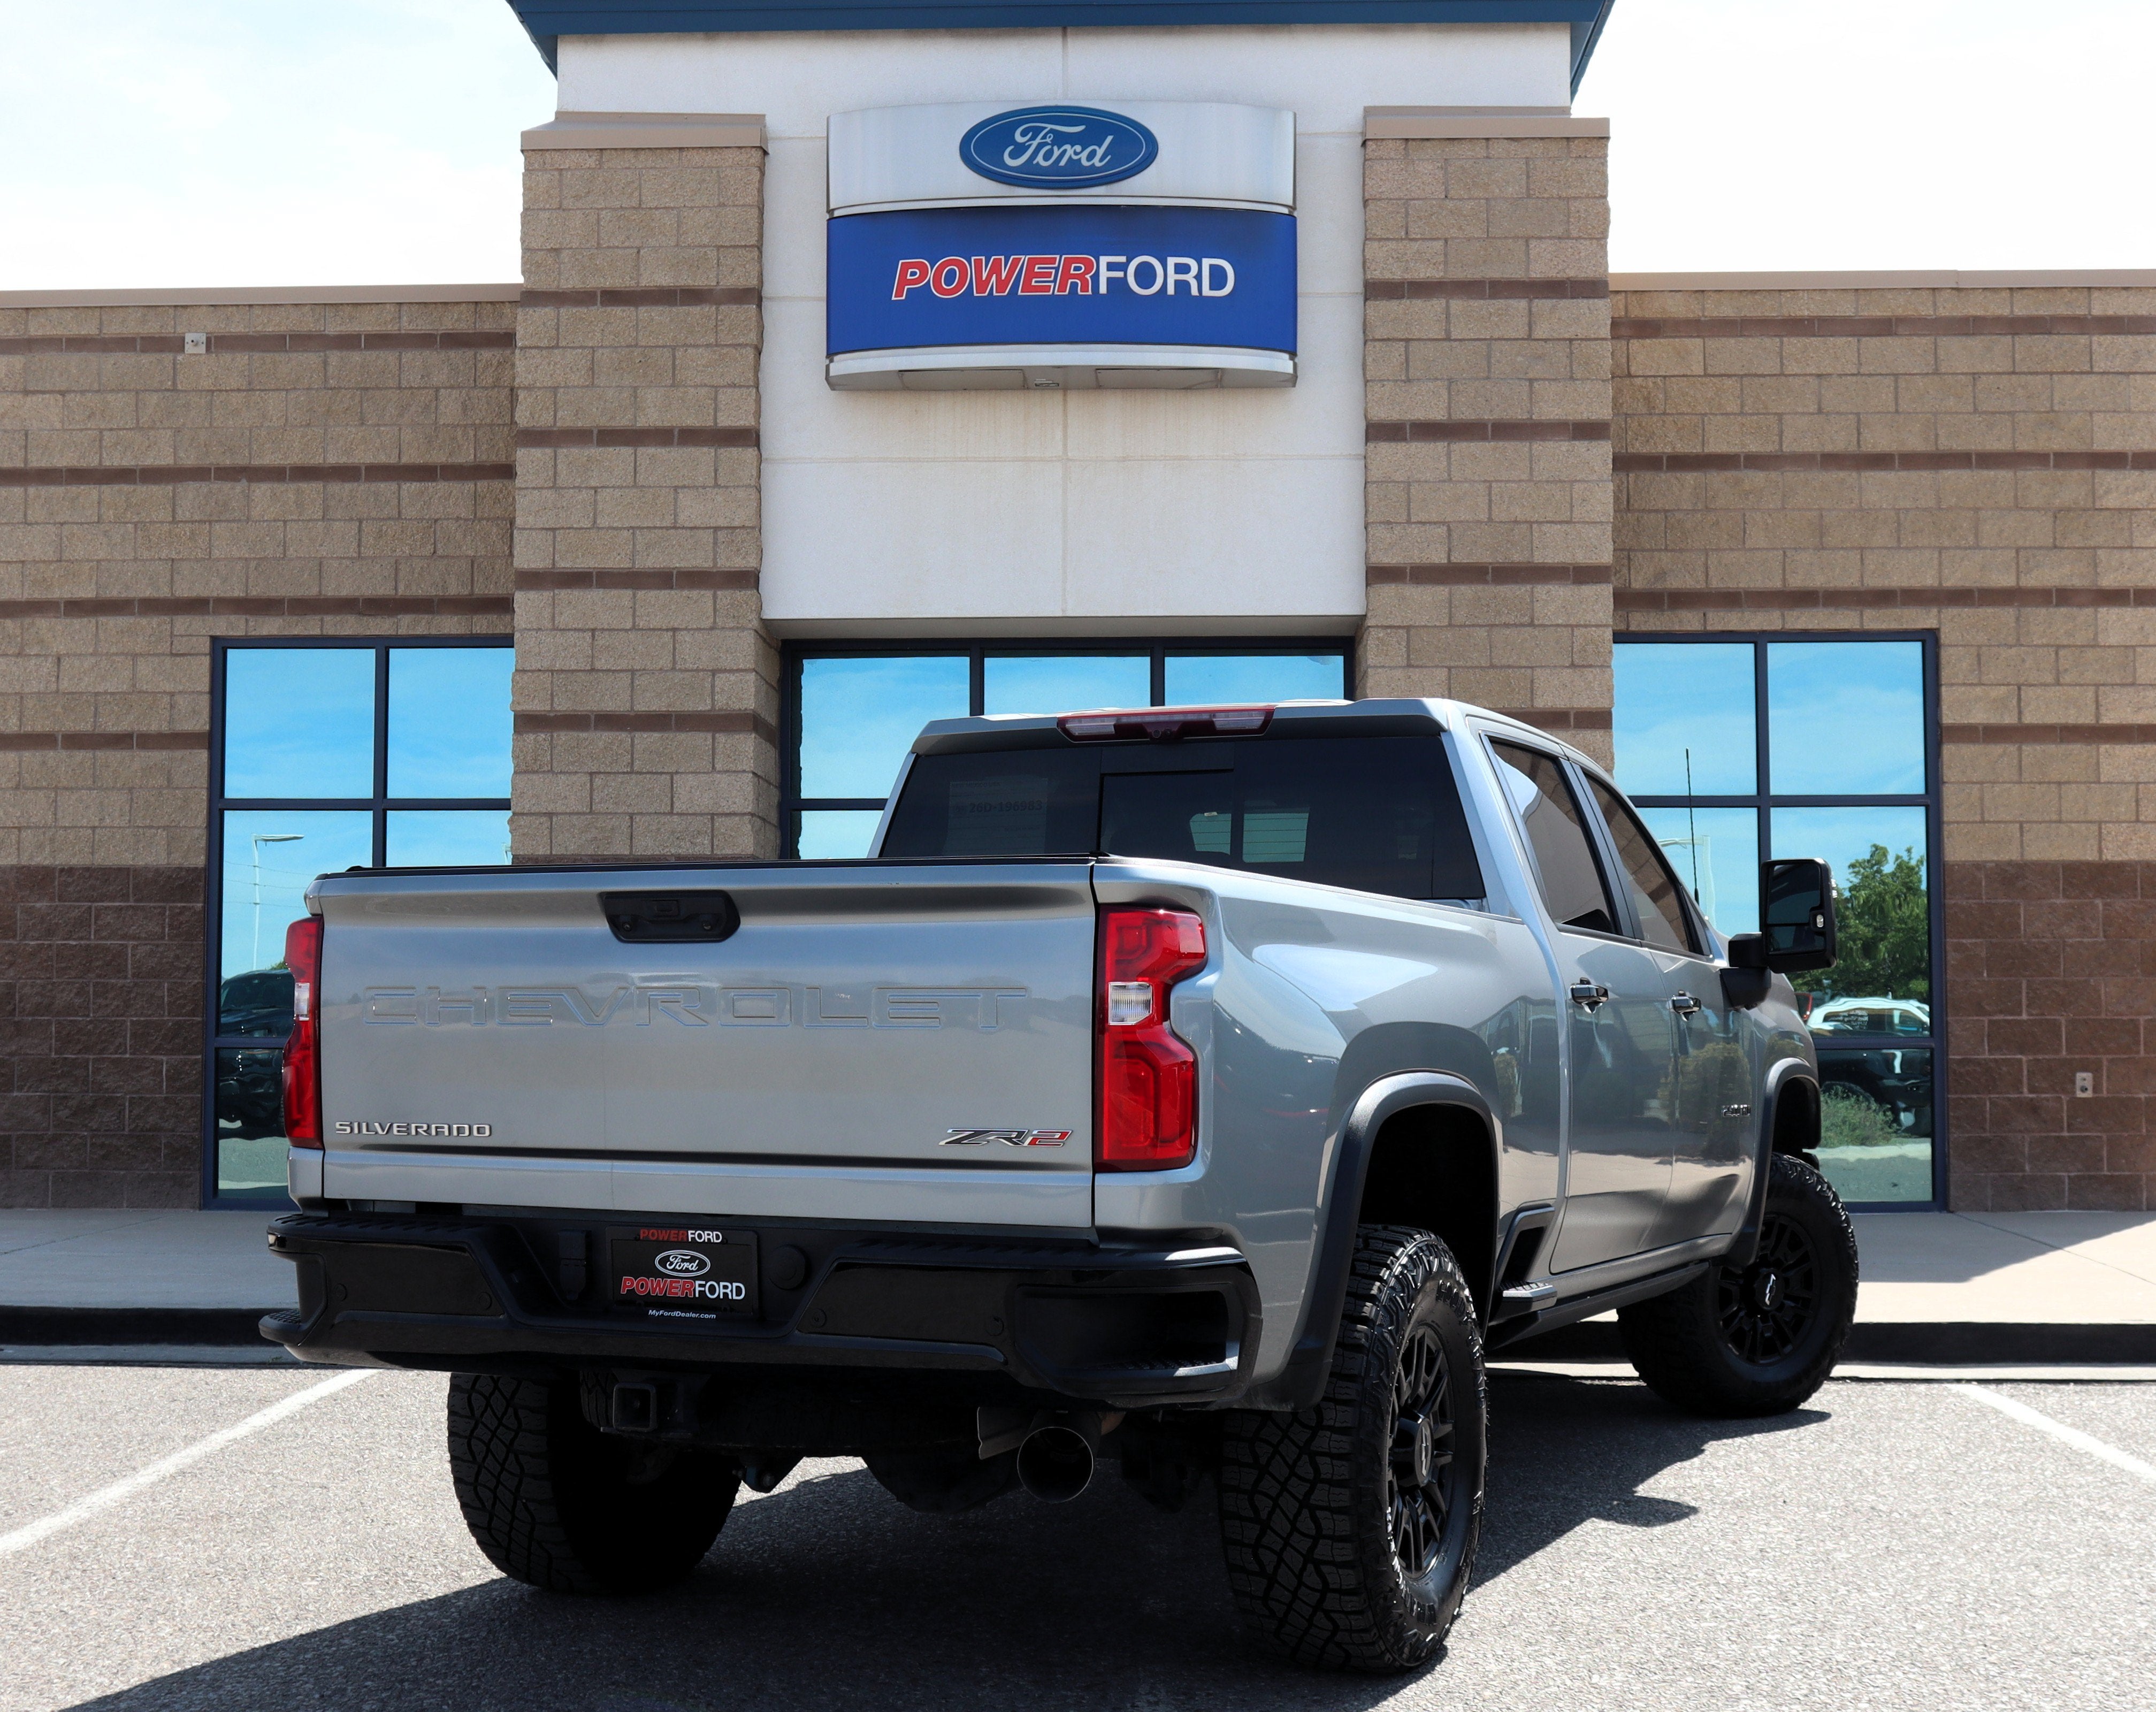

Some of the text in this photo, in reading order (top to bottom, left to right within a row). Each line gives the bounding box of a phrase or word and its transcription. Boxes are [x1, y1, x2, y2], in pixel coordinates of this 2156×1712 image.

[1004, 123, 1114, 167] Ford
[363, 986, 1027, 1029] CHEVROLET
[335, 1121, 491, 1137] SILVERADO
[938, 1128, 1073, 1148] ZR2
[666, 1254, 698, 1271] Ford
[648, 1309, 716, 1319] MyFordDealer.com
